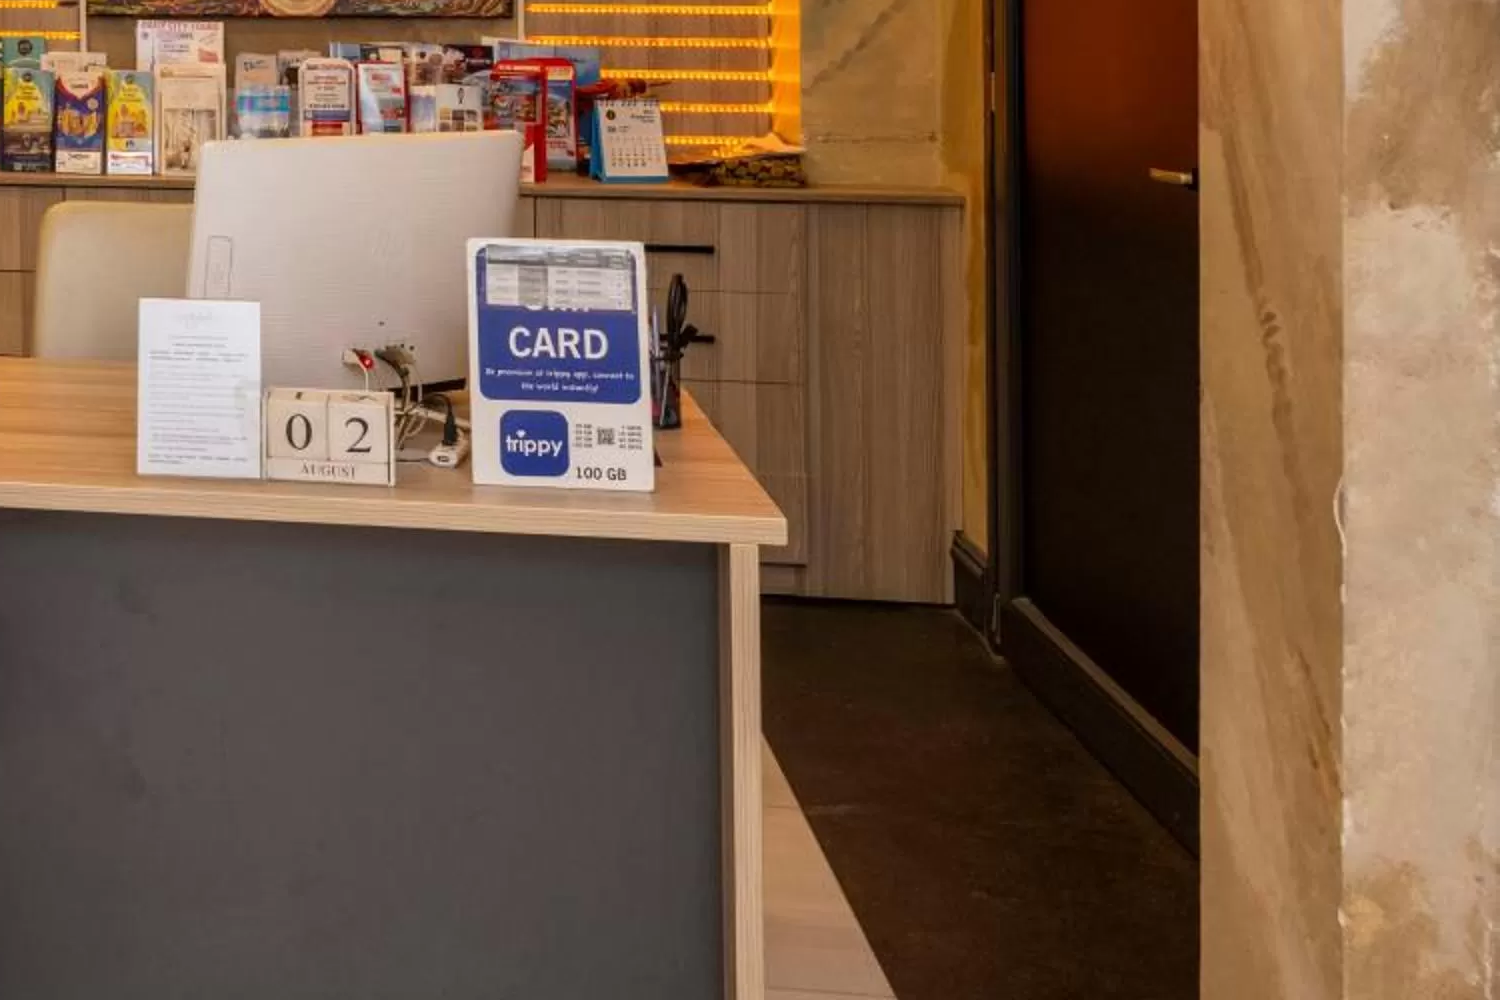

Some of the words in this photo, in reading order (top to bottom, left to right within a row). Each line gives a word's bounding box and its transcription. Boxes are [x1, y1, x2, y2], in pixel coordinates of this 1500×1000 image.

[508, 326, 609, 359] CARD
[505, 429, 563, 457] trippy
[300, 463, 356, 478] AUGUST
[576, 466, 603, 481] 100
[606, 467, 627, 481] GB
